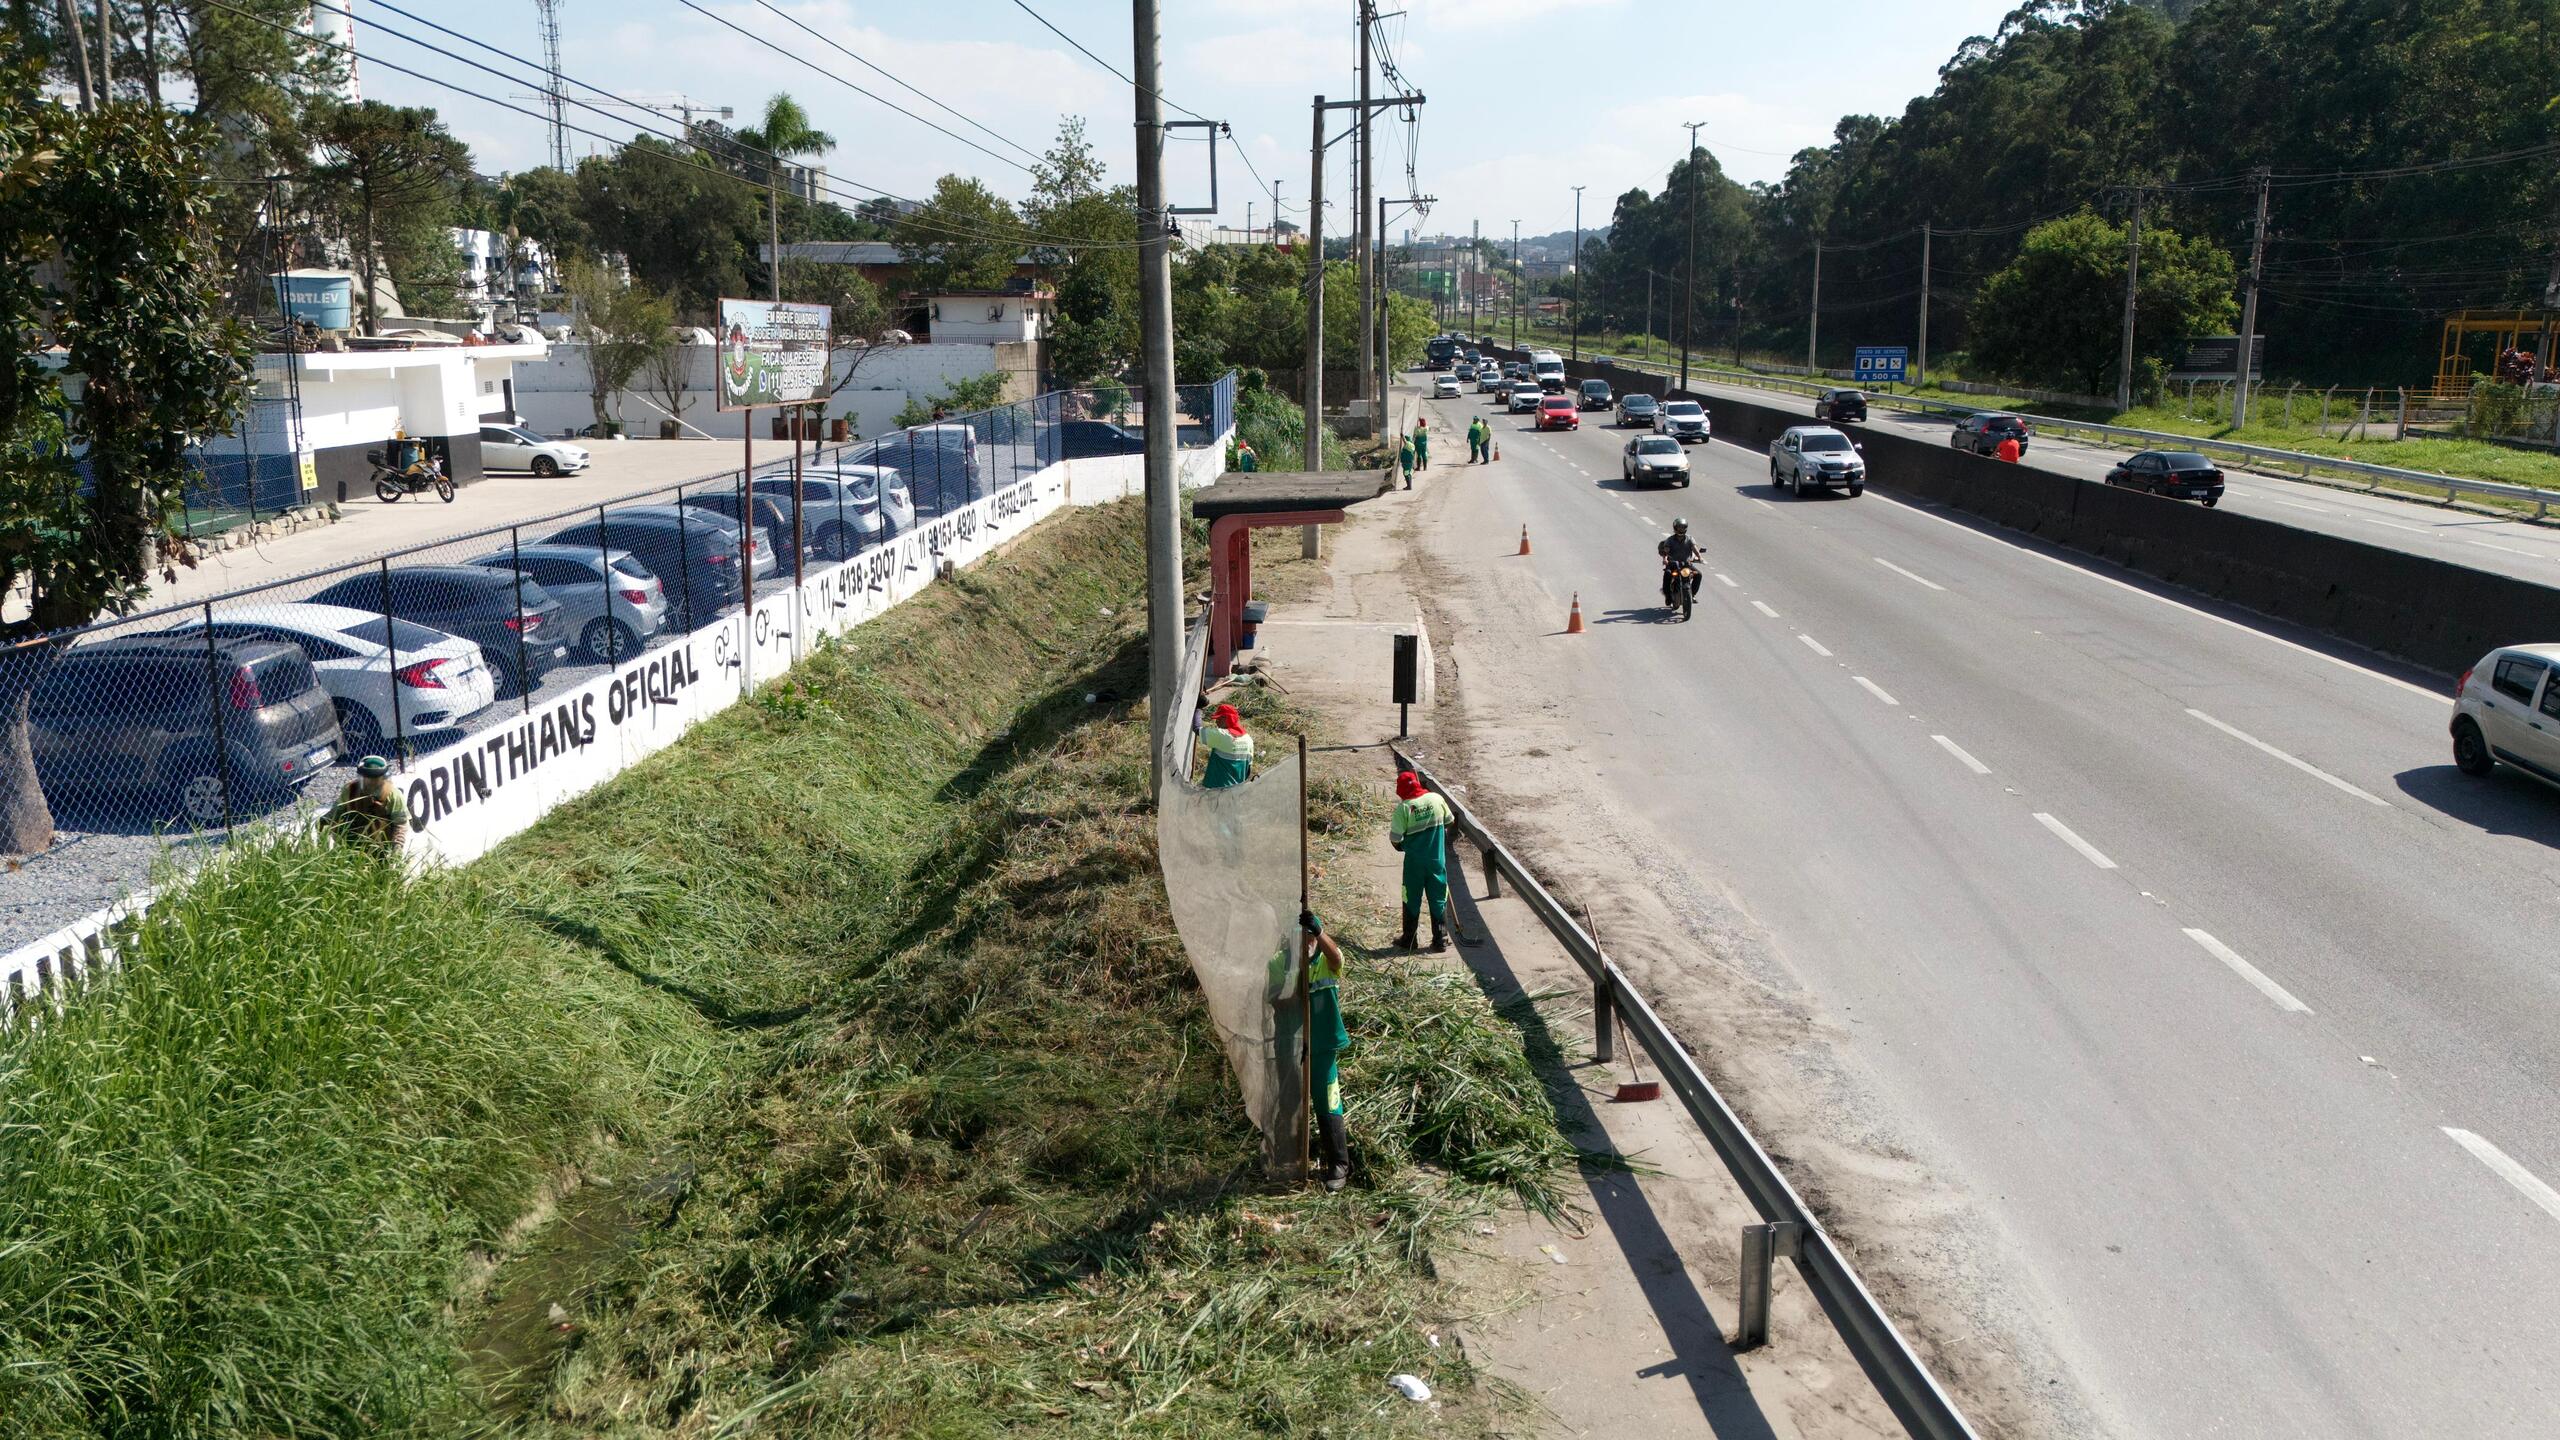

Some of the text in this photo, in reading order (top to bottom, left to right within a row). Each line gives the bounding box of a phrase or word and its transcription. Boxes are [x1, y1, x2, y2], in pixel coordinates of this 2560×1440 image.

[767, 311, 819, 326] EM BREVE QUADRAS
[798, 329, 814, 340] BEACH
[761, 351, 779, 369] FAÇA
[780, 351, 793, 366] SUA
[398, 644, 699, 833] ORINTHIANS OFICIAL
